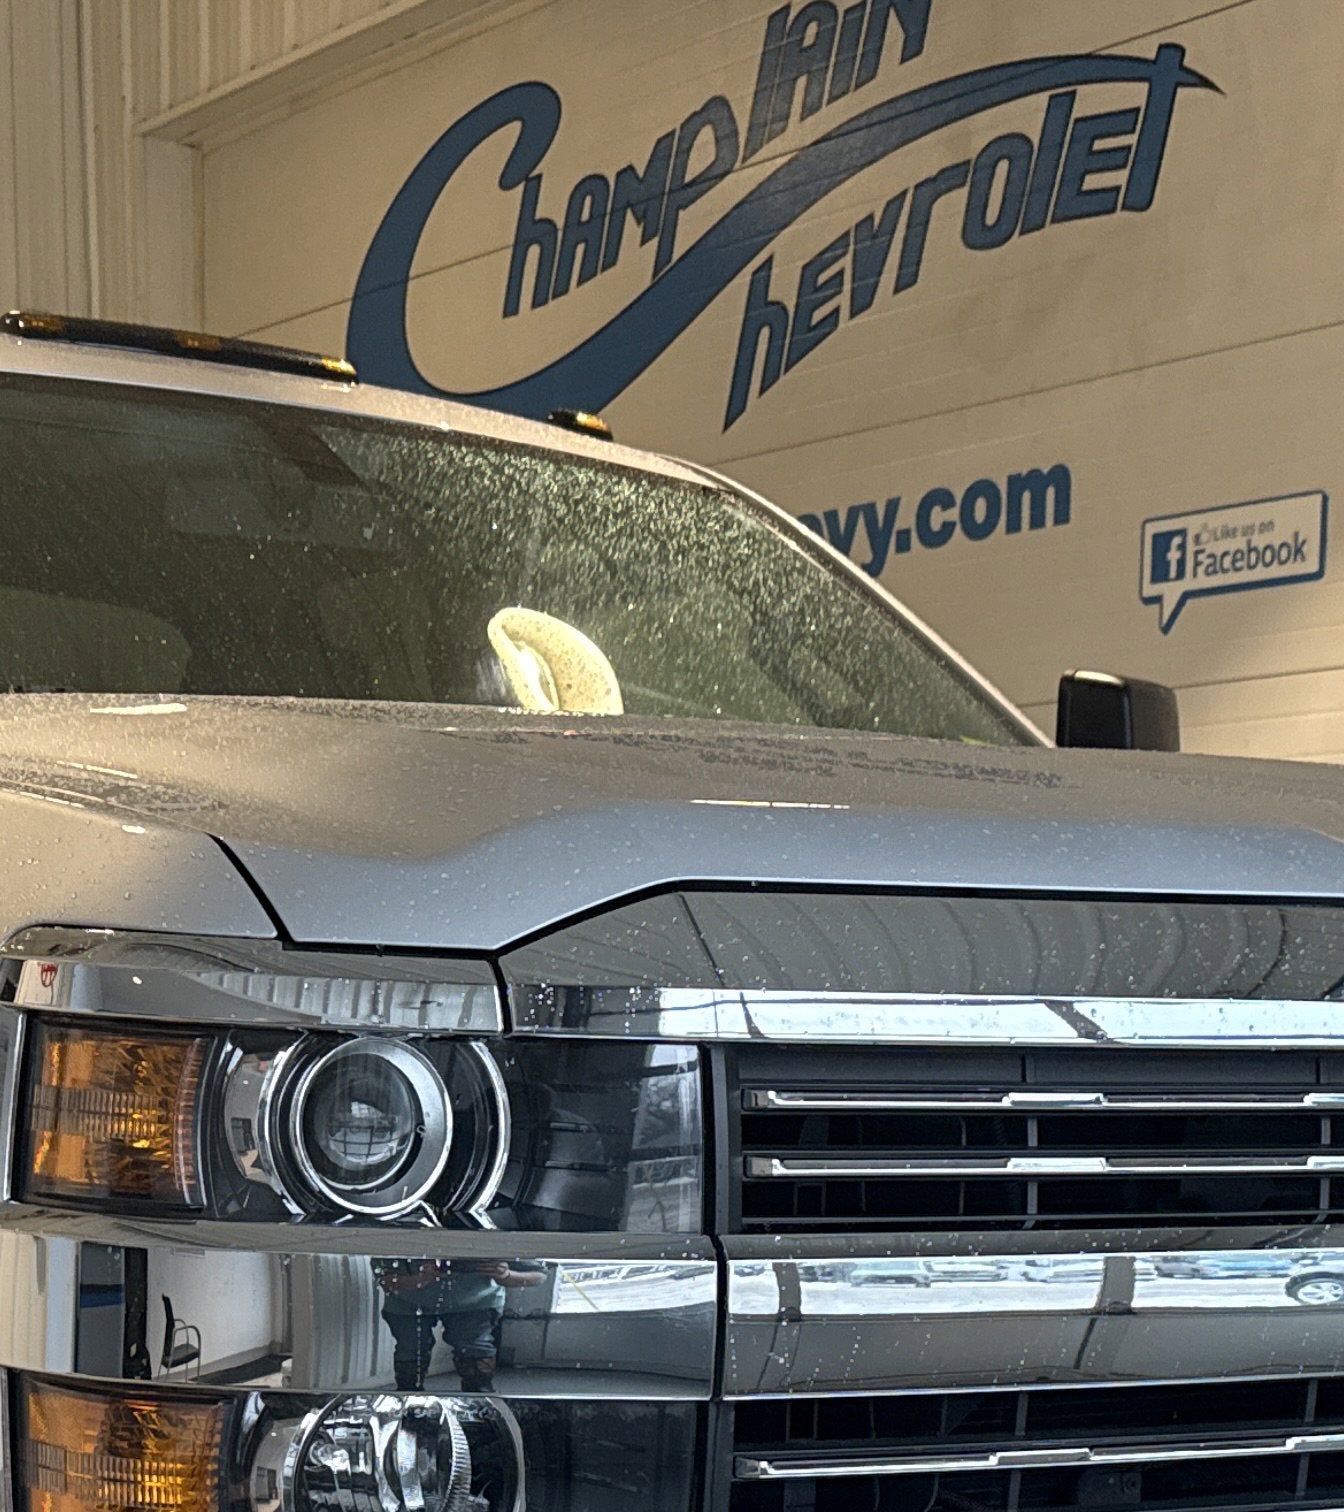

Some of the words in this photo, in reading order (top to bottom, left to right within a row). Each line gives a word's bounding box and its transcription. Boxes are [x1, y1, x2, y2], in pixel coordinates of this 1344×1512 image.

[1213, 524, 1237, 541] Like
[1241, 523, 1256, 537] us
[1258, 519, 1275, 534] on
[1192, 531, 1307, 579] Facebook
